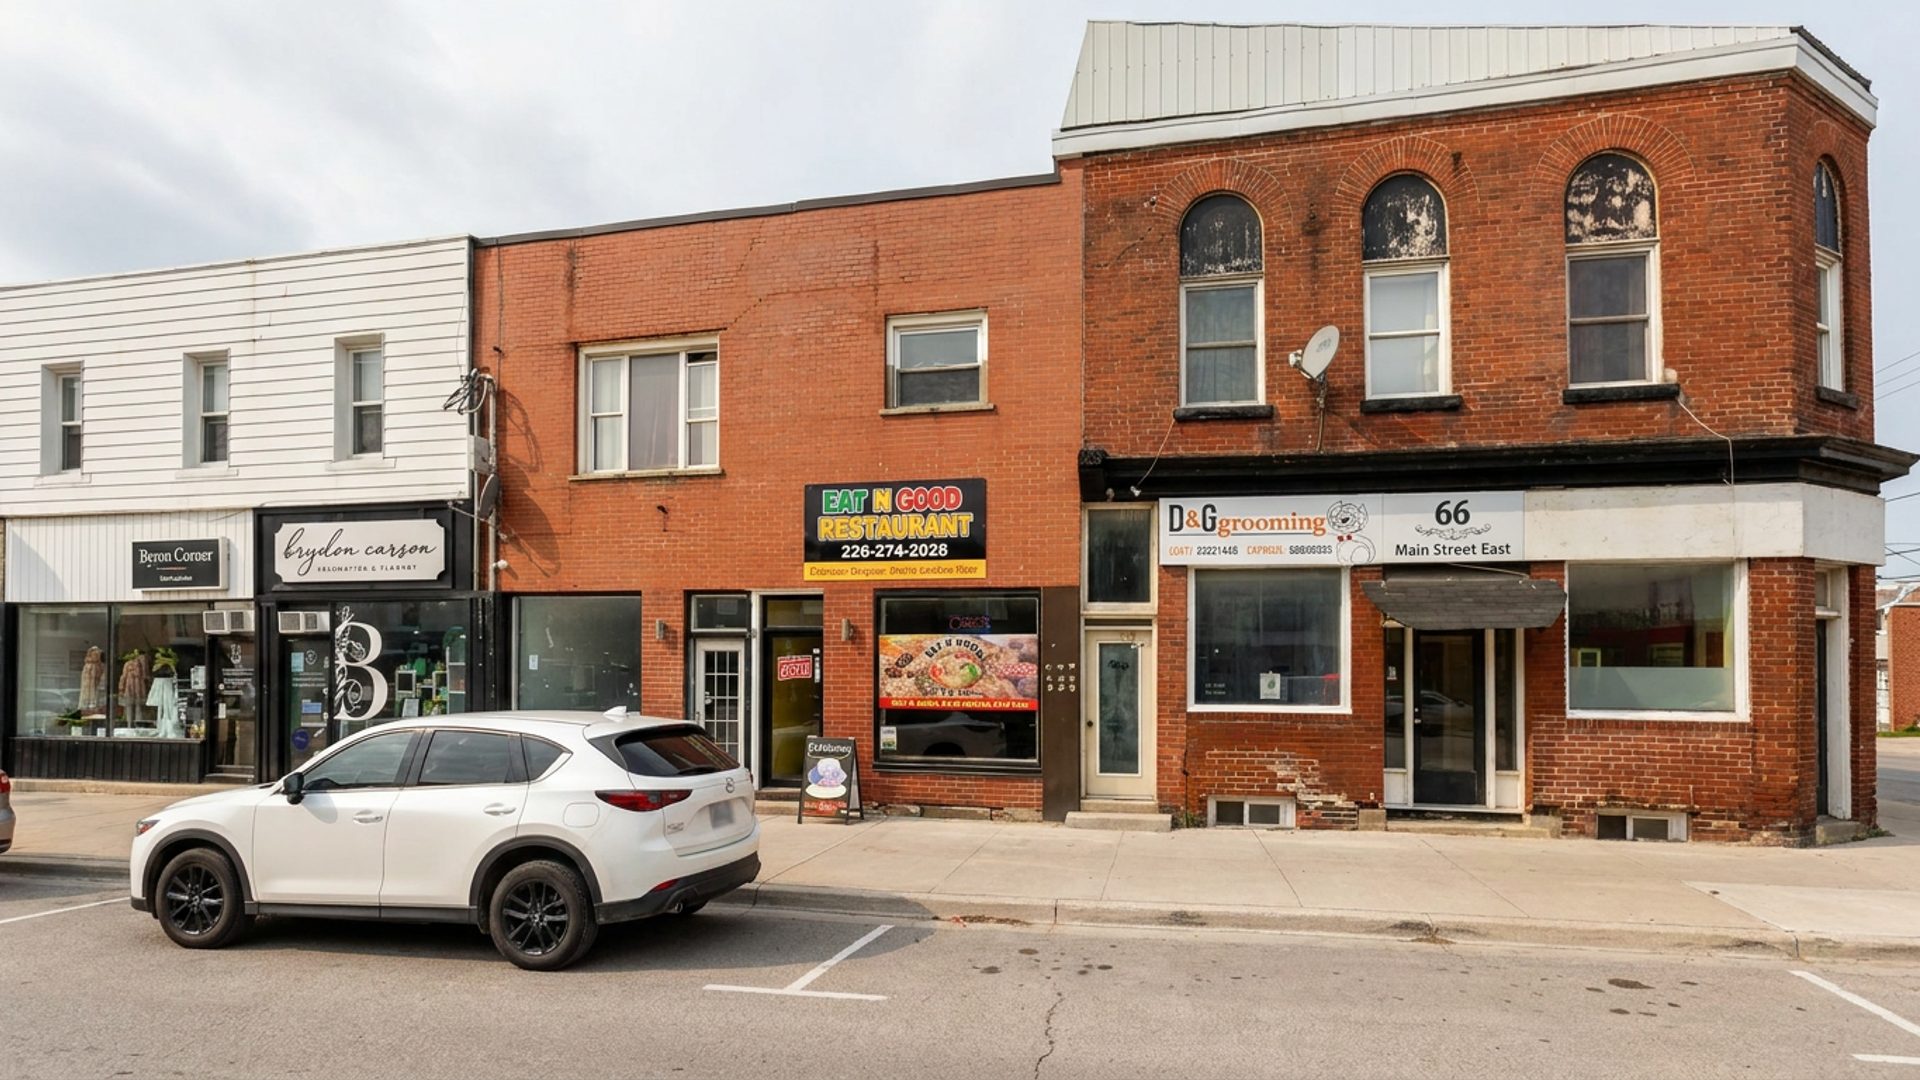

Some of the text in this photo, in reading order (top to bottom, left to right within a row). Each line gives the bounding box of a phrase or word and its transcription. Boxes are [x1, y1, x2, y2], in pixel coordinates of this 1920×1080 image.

[822, 486, 963, 514] EAT N GOOD
[1435, 499, 1470, 525] 66
[817, 512, 974, 541] RESTAURANT
[1168, 503, 1327, 538] D&G grooming
[283, 527, 437, 577] brydon carson
[841, 543, 948, 559] 226-274-2028
[1395, 542, 1511, 556] Main Street East
